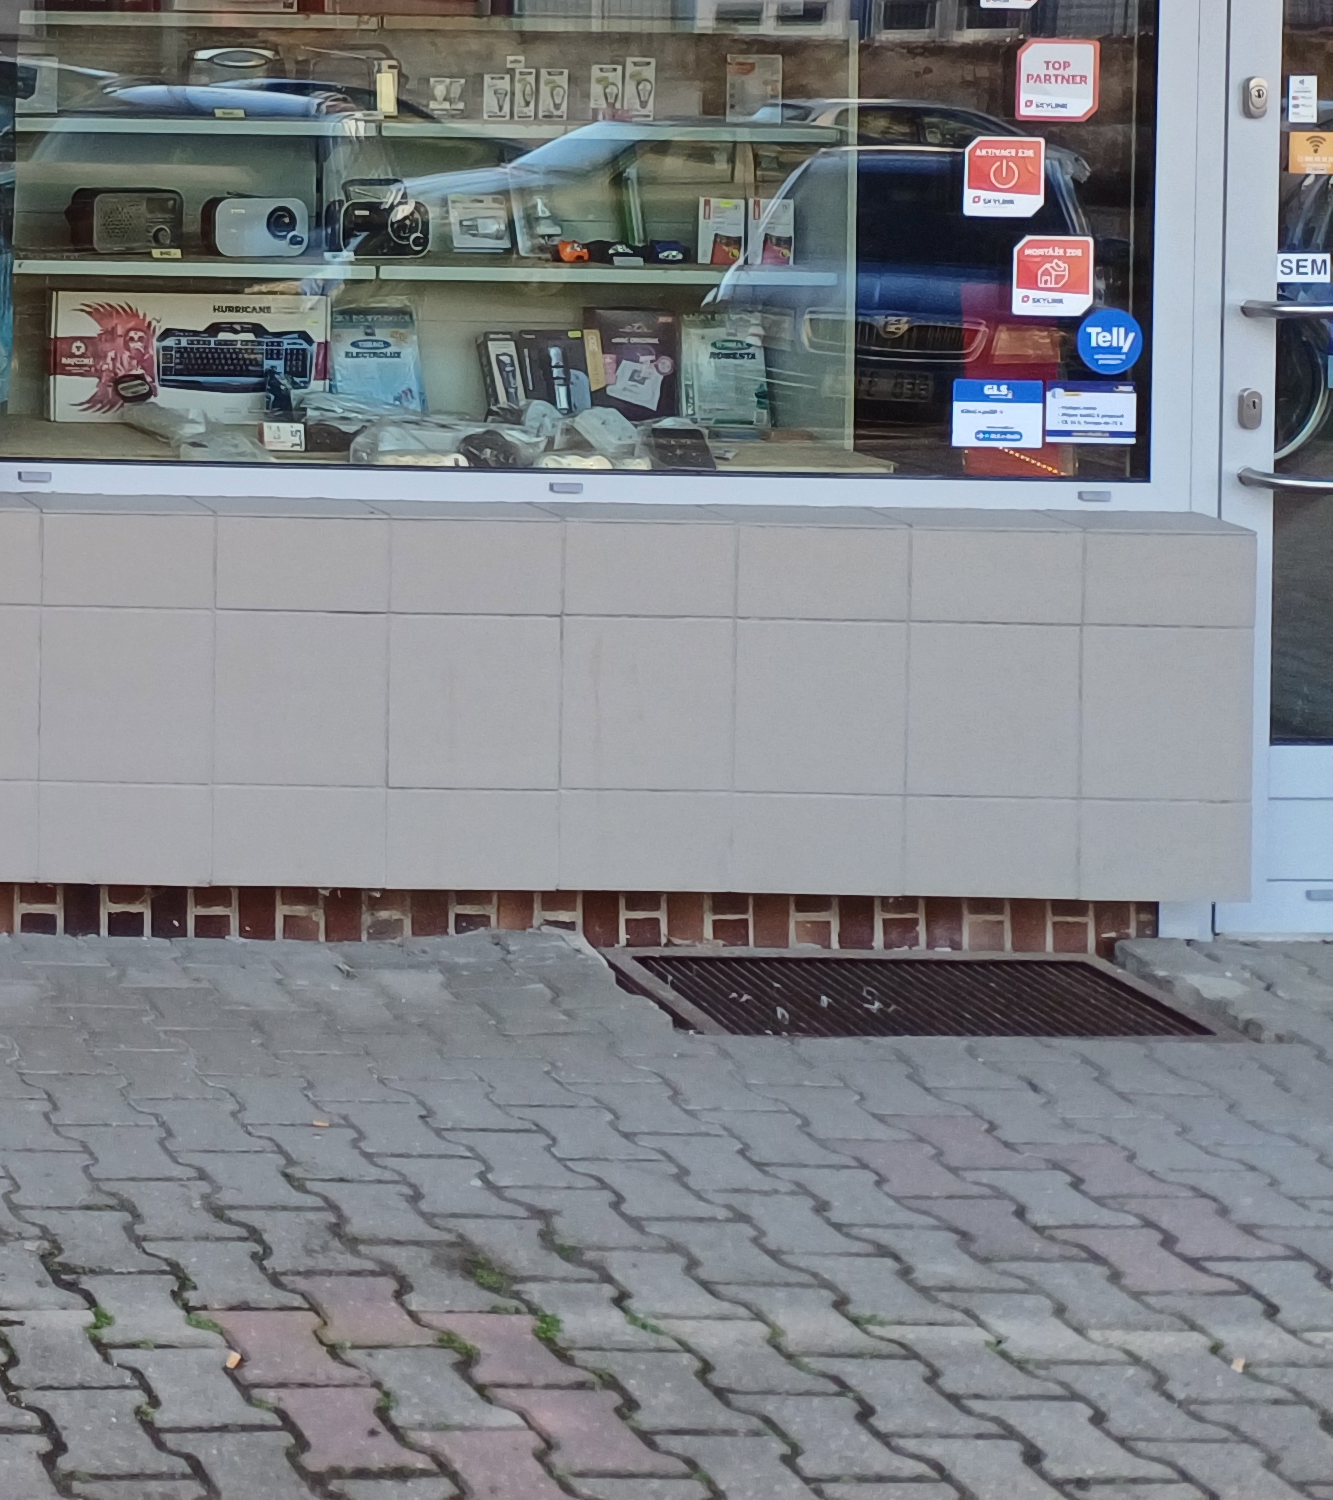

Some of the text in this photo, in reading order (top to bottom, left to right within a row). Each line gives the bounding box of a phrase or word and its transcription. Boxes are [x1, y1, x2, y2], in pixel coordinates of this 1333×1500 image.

[1043, 60, 1071, 71] TOP
[1025, 73, 1088, 86] PARTNER
[1279, 258, 1328, 276] SEM
[1086, 326, 1136, 353] Telly
